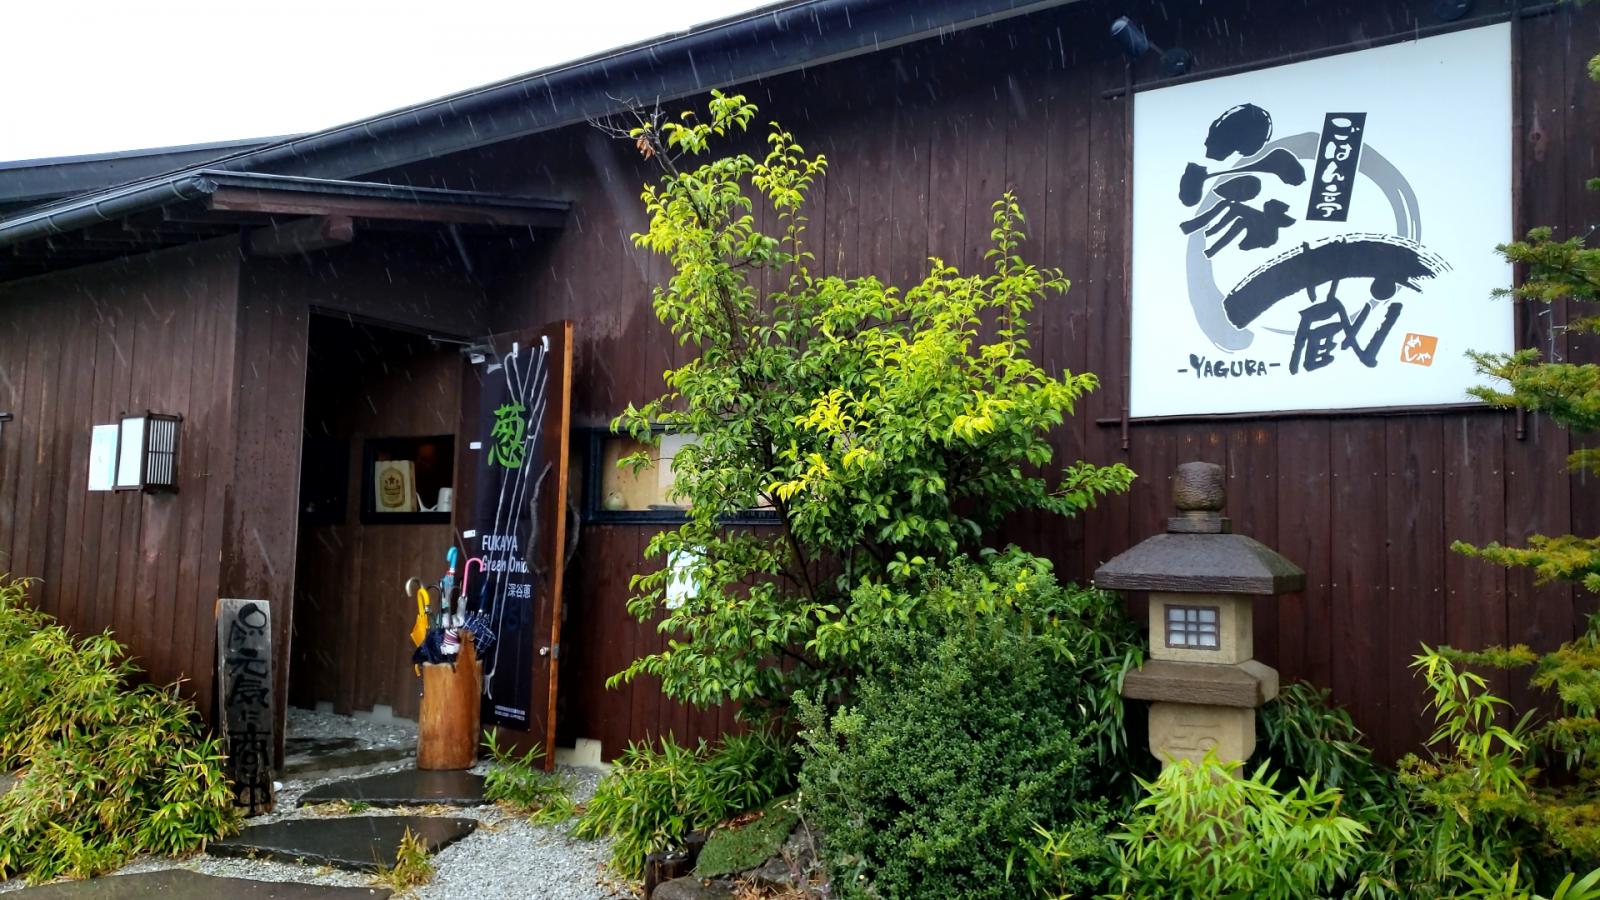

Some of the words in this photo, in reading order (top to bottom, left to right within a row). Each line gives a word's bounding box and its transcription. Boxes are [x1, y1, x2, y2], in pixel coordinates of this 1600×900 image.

[1315, 117, 1360, 218] ごはん亭
[482, 534, 518, 552] FUKAYA
[482, 554, 507, 572] Green
[508, 556, 530, 574] Onio
